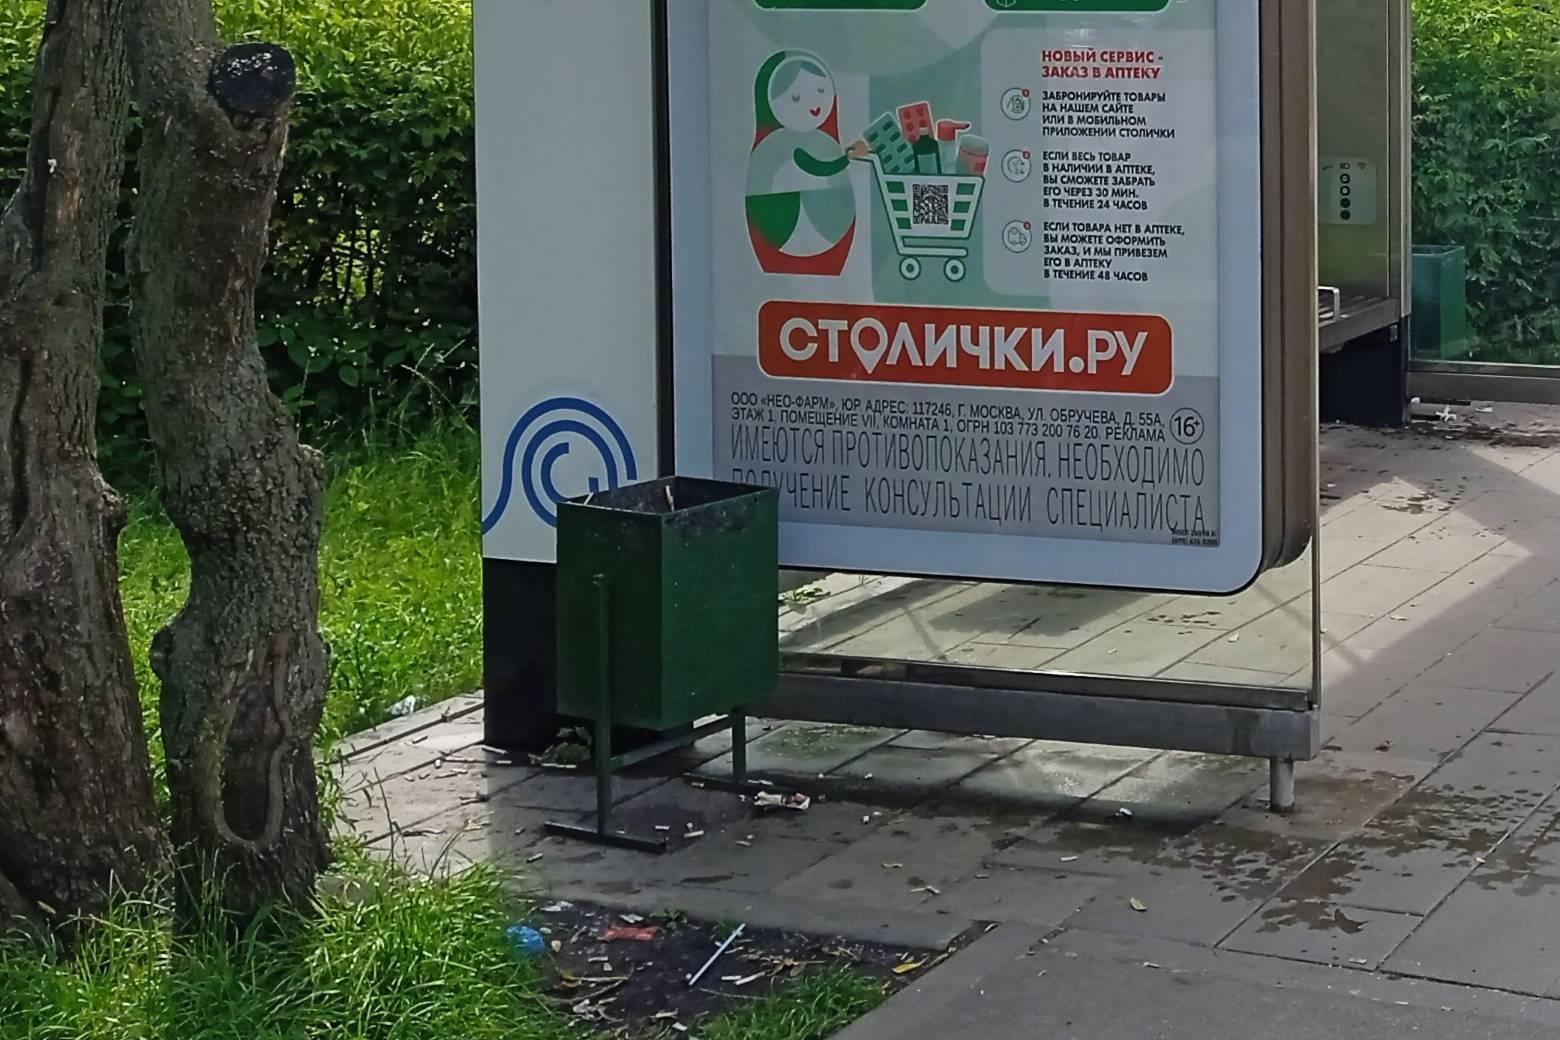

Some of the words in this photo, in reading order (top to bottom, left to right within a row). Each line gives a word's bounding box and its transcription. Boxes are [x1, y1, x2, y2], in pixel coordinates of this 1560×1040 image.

[1042, 47, 1096, 63] НОВЫЙ
[1100, 51, 1154, 63] СЕРВИС
[1042, 66, 1089, 78] ЗАКАЗ
[1093, 67, 1101, 78] В
[1105, 67, 1161, 79] АПТЕКУ
[1042, 90, 1121, 102] ЗАБРОНИРУЙТЕ
[1125, 91, 1166, 102] ТОВАРЫ
[1042, 104, 1057, 112] НА
[1060, 104, 1099, 113] НАШЕМ
[1102, 102, 1134, 114] САЙТЕ
[1042, 115, 1065, 124] ИЛИ
[1067, 115, 1074, 125] В
[1076, 115, 1146, 126] МОБИЛЬНОМ
[1042, 127, 1117, 137] ПРИЛОЖЕНИИ
[1119, 128, 1175, 138] СТОЛИЧКИ
[1043, 151, 1069, 161] ЕСЛИ
[1072, 152, 1096, 161] ВЕСЬ
[1099, 152, 1131, 162] ТОВАР
[1043, 163, 1049, 172] В
[1052, 164, 1103, 174] НАЛИЧИИ
[1106, 164, 1112, 174] В
[1115, 165, 1155, 176] АПТЕКЕ,
[1043, 175, 1057, 184] ВЫ
[1060, 176, 1109, 186] СМОЖЕТЕ
[1112, 176, 1155, 186] ЗАБРАТЬ
[1044, 187, 1061, 196] ЕГО
[1064, 188, 1093, 197] ЧЕРЕЗ
[1096, 188, 1109, 198] 30
[1111, 188, 1139, 198] МИН.
[1044, 199, 1050, 208] В
[1052, 200, 1095, 208] ТЕЧЕНИЕ
[1097, 200, 1110, 209] 24
[1113, 200, 1148, 210] ЧАСОВ
[1044, 222, 1070, 232] ЕСЛИ
[1072, 223, 1112, 232] ТОВАРА
[1114, 224, 1132, 233] НЕТ
[1135, 224, 1142, 234] В
[1144, 225, 1185, 236] АПТЕКЕ,
[1044, 234, 1058, 244] ВЫ
[1061, 235, 1103, 244] МОЖЕТЕ
[1106, 236, 1166, 246] ОФОРМИТЬ
[1044, 246, 1080, 256] ЗАКАЗ,
[1083, 247, 1091, 256] И
[1094, 247, 1112, 256] МЫ
[1114, 248, 1168, 258] ПРИВЕЗЕМ
[1044, 258, 1062, 267] ЕГО
[1064, 258, 1070, 268] В
[1073, 259, 1112, 269] АПТЕКУ
[1044, 270, 1050, 278] В
[1052, 270, 1095, 280] ТЕЧЕНИЕ
[1097, 271, 1110, 280] 48
[1113, 272, 1148, 281] ЧАСОВ
[779, 316, 1148, 378] СТОЛИЧКИ.РУ
[731, 392, 758, 406] ООО
[865, 400, 909, 416] АДРЕС:
[913, 402, 954, 418] 117246,
[970, 405, 1024, 421] МОСКВА,
[1027, 408, 1046, 422] УЛ.
[1050, 408, 1120, 426] ОБРУЧЕВА,
[732, 407, 764, 421] ЭТАЖ
[780, 410, 858, 429] ПОМЕЩЕНИЕ
[883, 416, 940, 432] КОМНАТА
[957, 420, 990, 434] ОГРН
[994, 422, 1014, 435] 103
[1018, 422, 1038, 436] 773
[1042, 424, 1063, 438] 200
[1066, 425, 1080, 439] 76
[1084, 426, 1101, 440] 20.
[1106, 426, 1166, 442] РЕКЛАМА
[1174, 416, 1201, 437] 16+
[731, 425, 825, 465] ИМЕЮТСЯ
[832, 430, 1052, 478] ПРОТИВОПОКАЗАНИЯ.
[1058, 443, 1204, 488] НЕОБХОДИМО
[865, 477, 1032, 524] КОНСУЛЬТАЦИИ
[1046, 487, 1206, 534] СПЕЦИАЛИСТА
